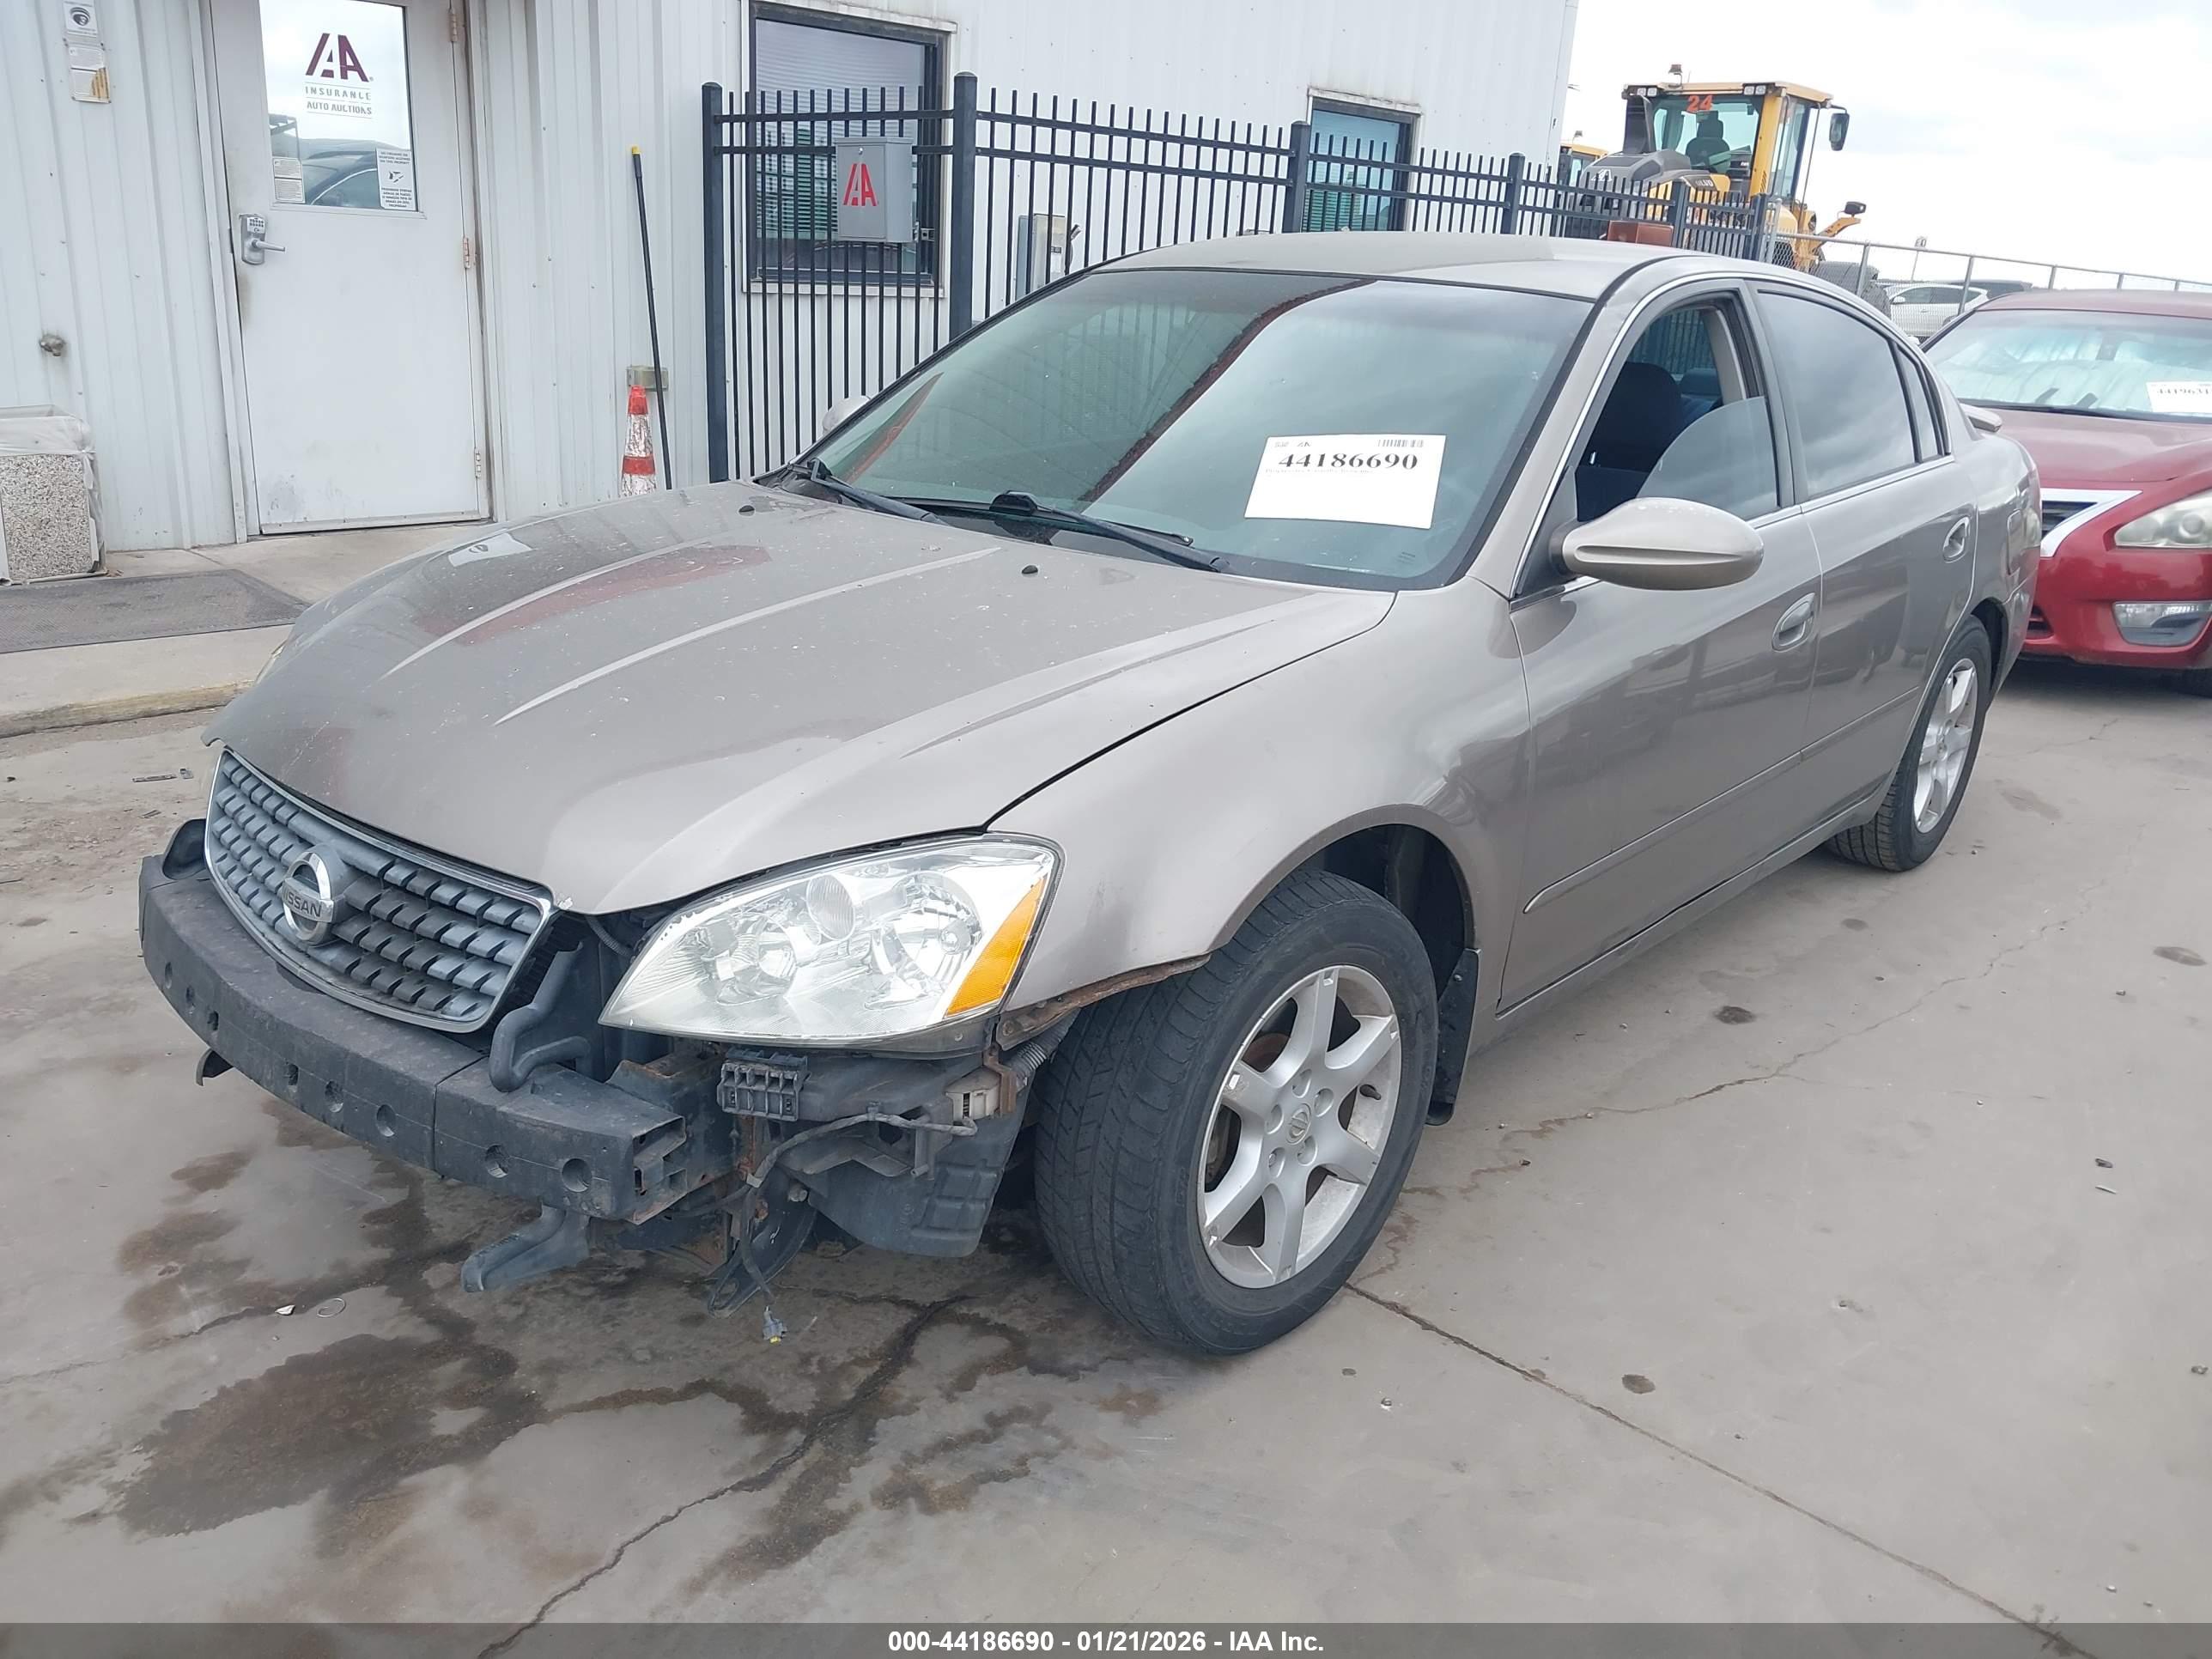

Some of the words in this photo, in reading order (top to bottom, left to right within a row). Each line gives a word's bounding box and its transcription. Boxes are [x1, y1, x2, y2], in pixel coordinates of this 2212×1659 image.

[307, 101, 330, 111] AUTO
[331, 103, 373, 115] AUCTIONS
[1686, 94, 1713, 112] 24
[1279, 453, 1419, 470] 44186690
